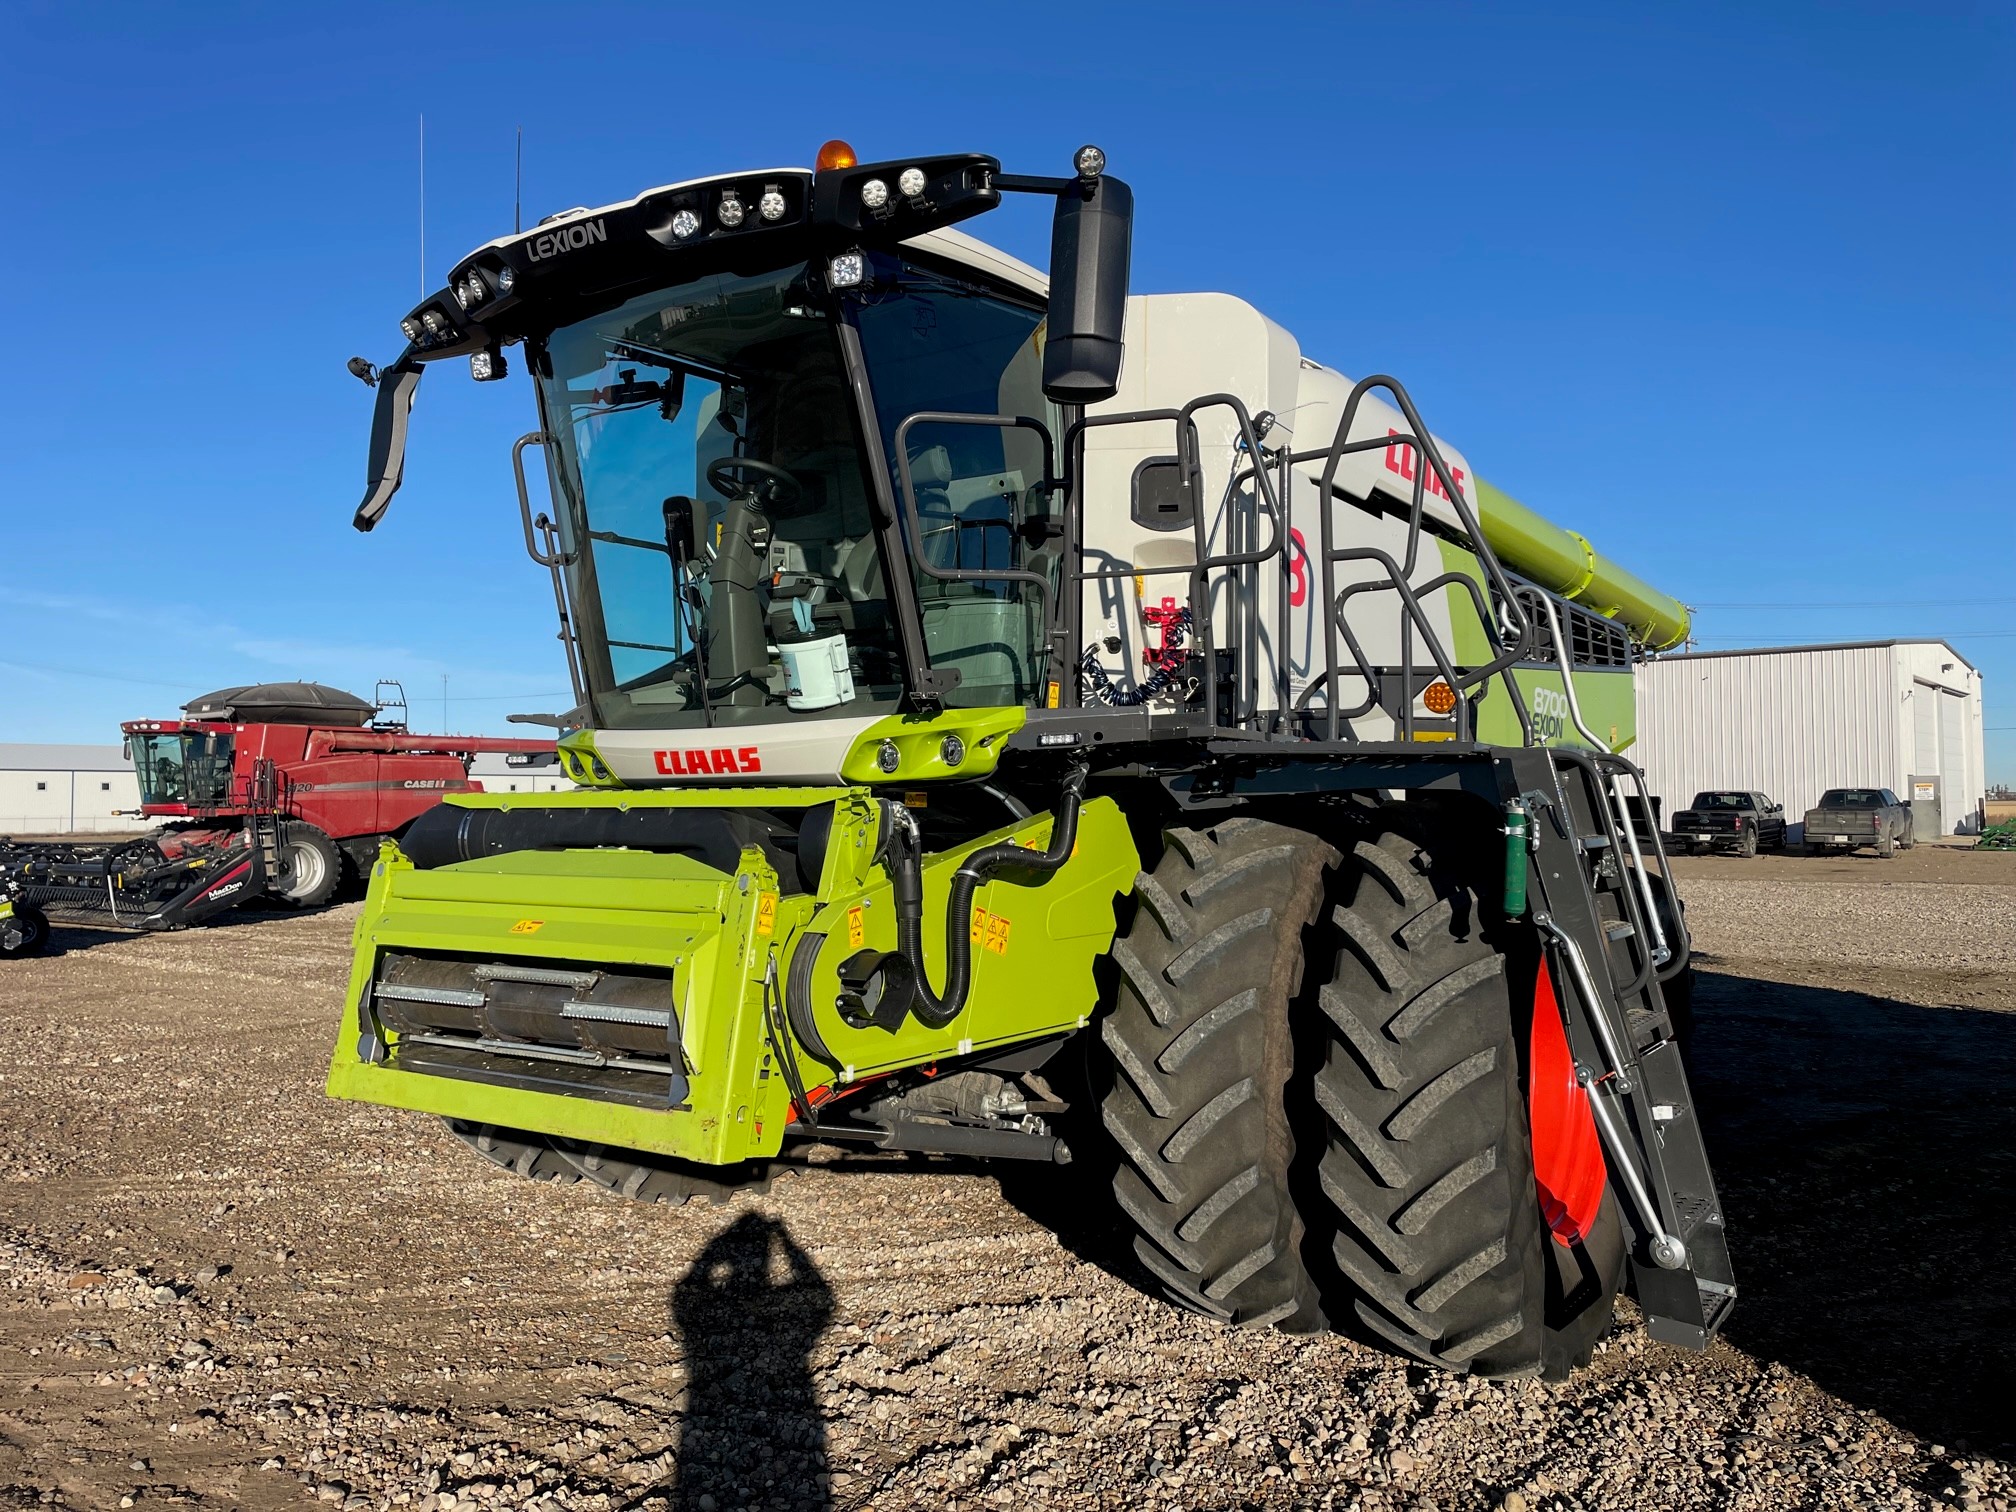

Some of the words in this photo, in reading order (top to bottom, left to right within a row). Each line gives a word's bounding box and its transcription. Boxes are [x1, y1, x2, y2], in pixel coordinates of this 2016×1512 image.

[526, 219, 607, 262] LEXION
[1534, 687, 1568, 719] 8700
[1527, 711, 1563, 739] EXION
[653, 747, 761, 775] CLAAS
[404, 780, 435, 788] CASE
[208, 881, 243, 898] MacDon
